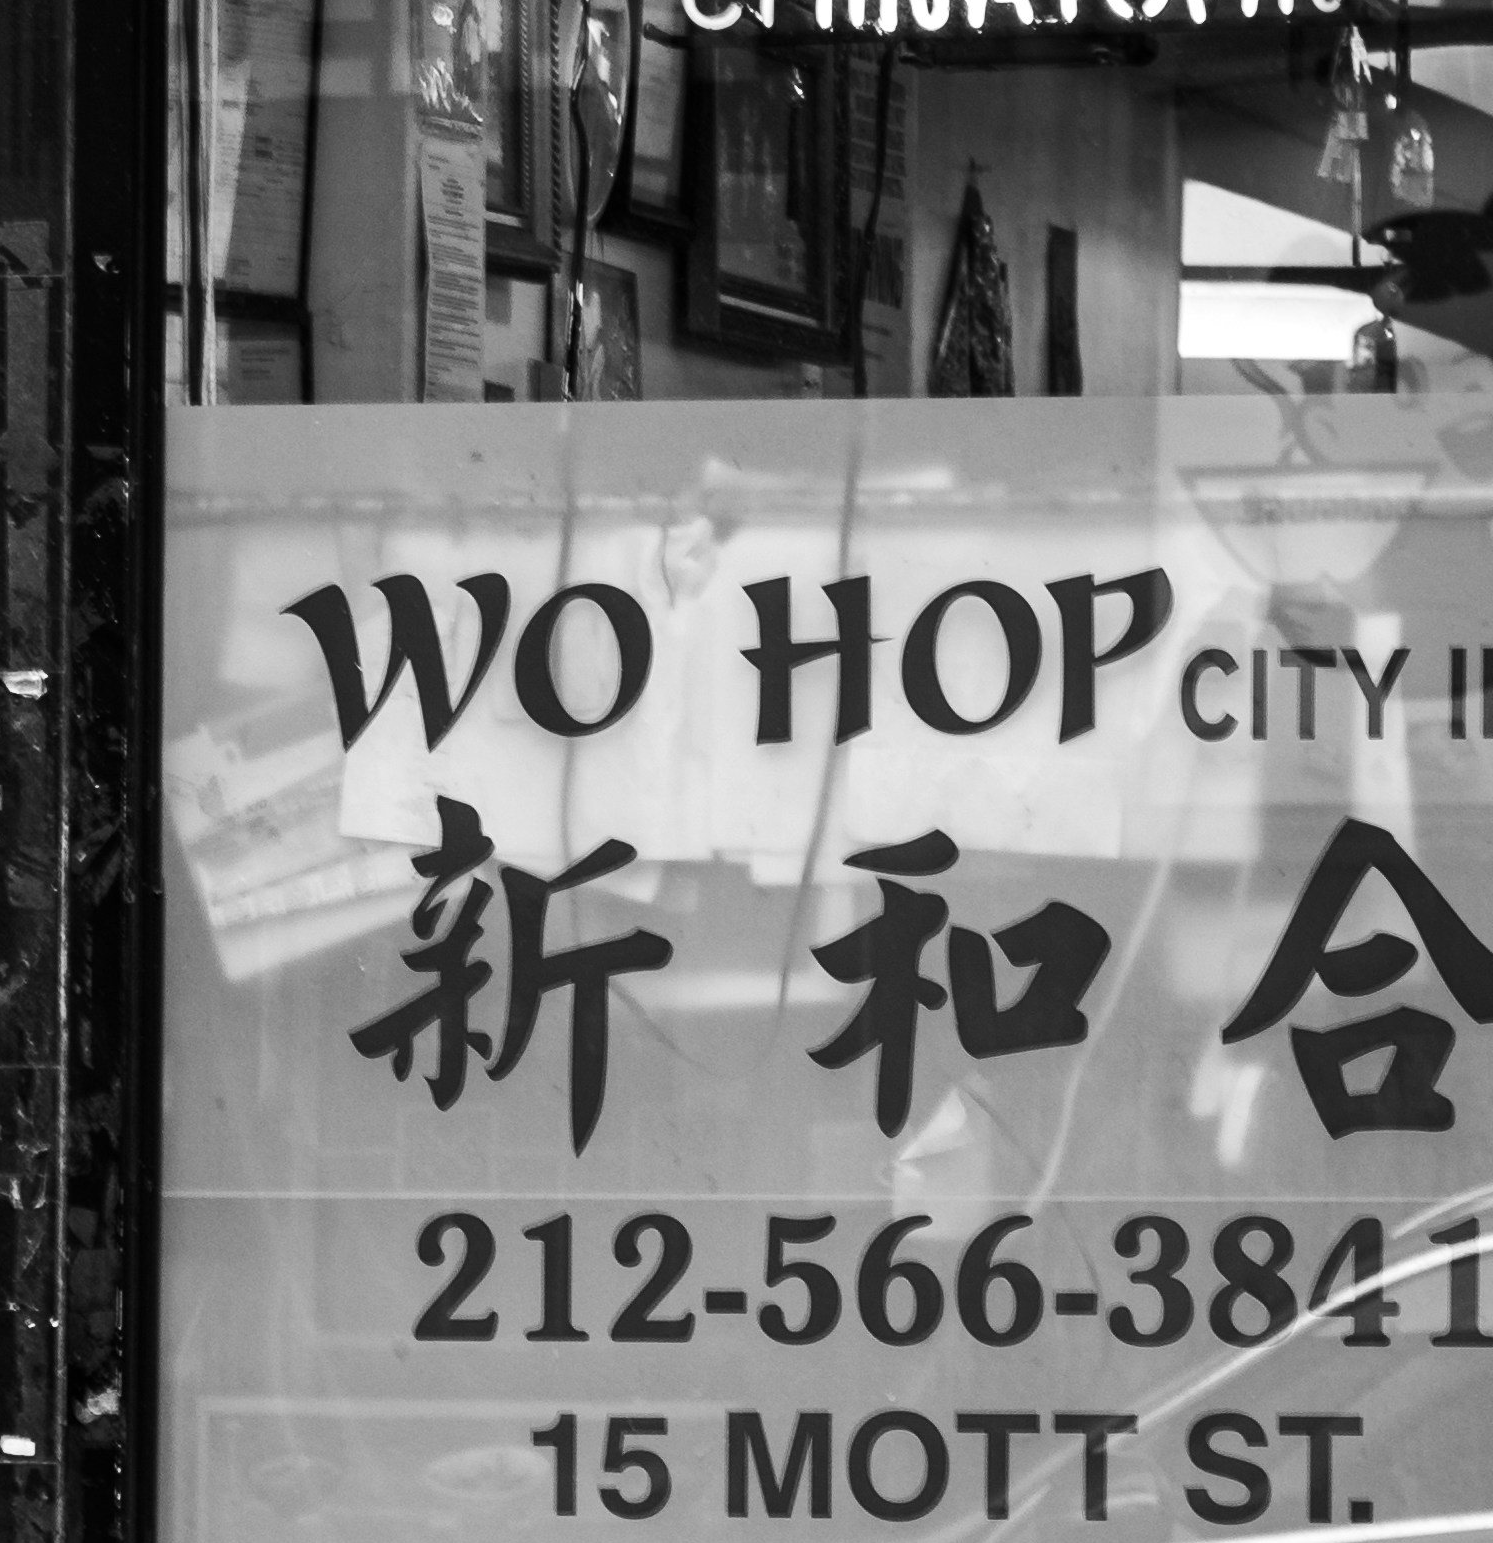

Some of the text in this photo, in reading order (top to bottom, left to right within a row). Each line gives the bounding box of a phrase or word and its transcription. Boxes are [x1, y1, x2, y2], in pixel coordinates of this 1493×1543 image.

[279, 570, 654, 754] WO
[739, 566, 1174, 747] HOP
[1179, 647, 1412, 743] CITY
[349, 795, 1493, 1159] 新和合
[413, 1213, 1493, 1350] 212-566-3841
[532, 1409, 1375, 1526] 15 MOTT ST.
